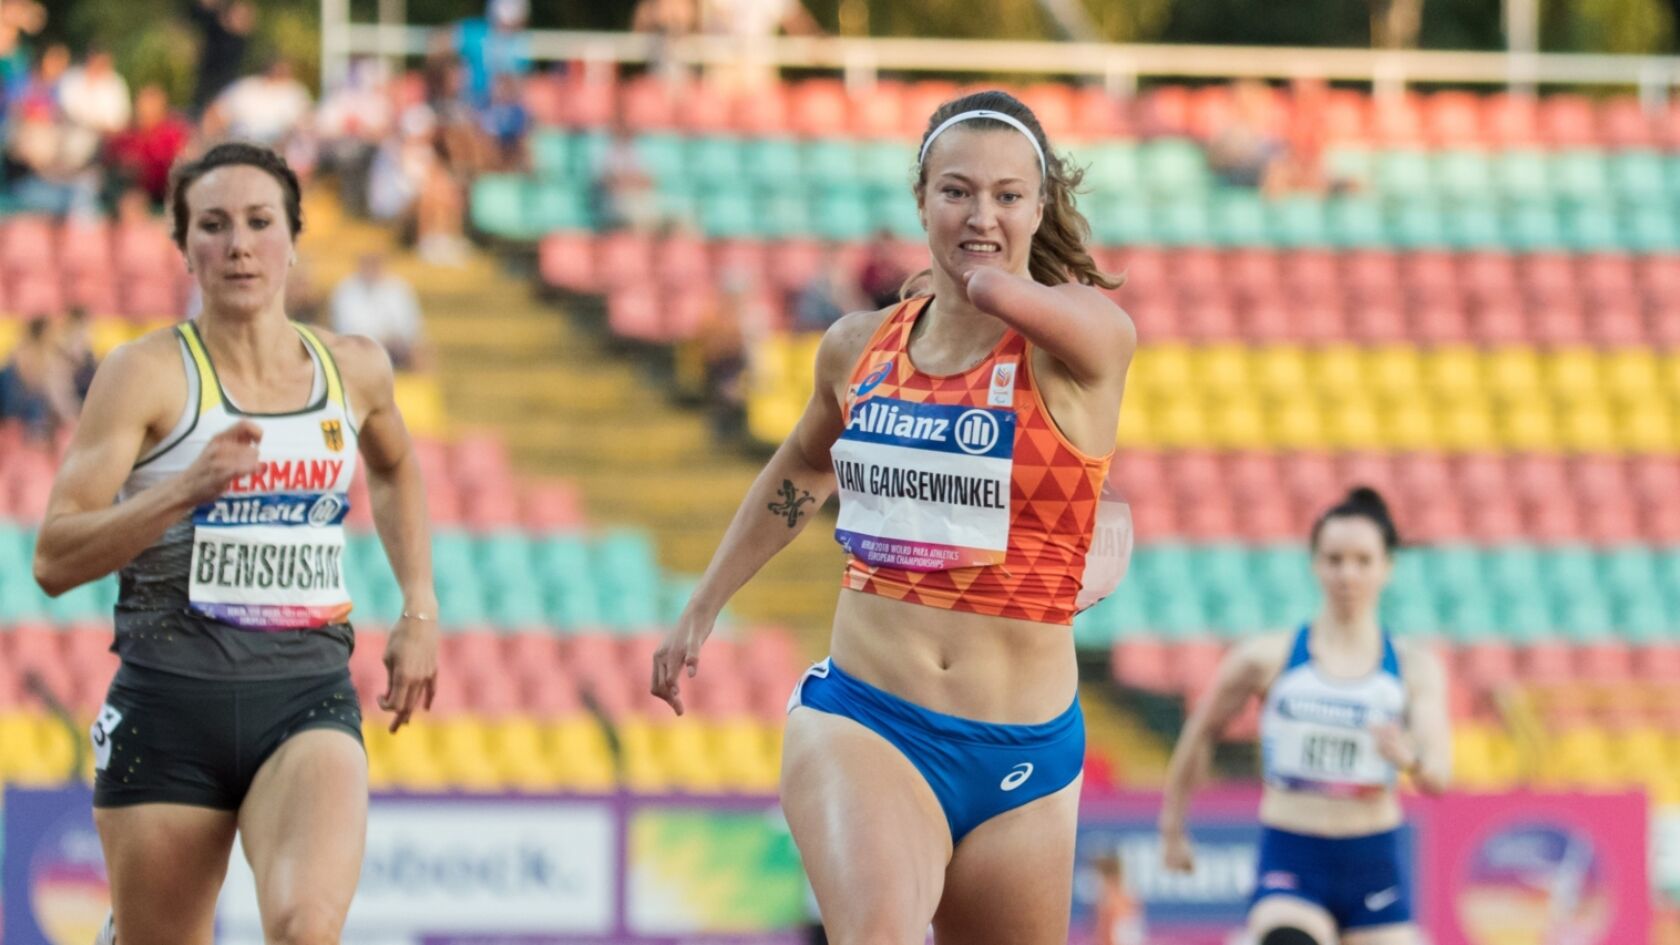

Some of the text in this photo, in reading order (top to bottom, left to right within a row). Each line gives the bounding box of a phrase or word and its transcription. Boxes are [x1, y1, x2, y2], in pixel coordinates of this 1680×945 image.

[846, 402, 949, 442] Allianz
[226, 460, 343, 493] ERMANY
[835, 459, 1005, 509] VAN GANSEWINKEL
[207, 499, 306, 523] Allianz
[195, 541, 341, 590] BENSUSAN
